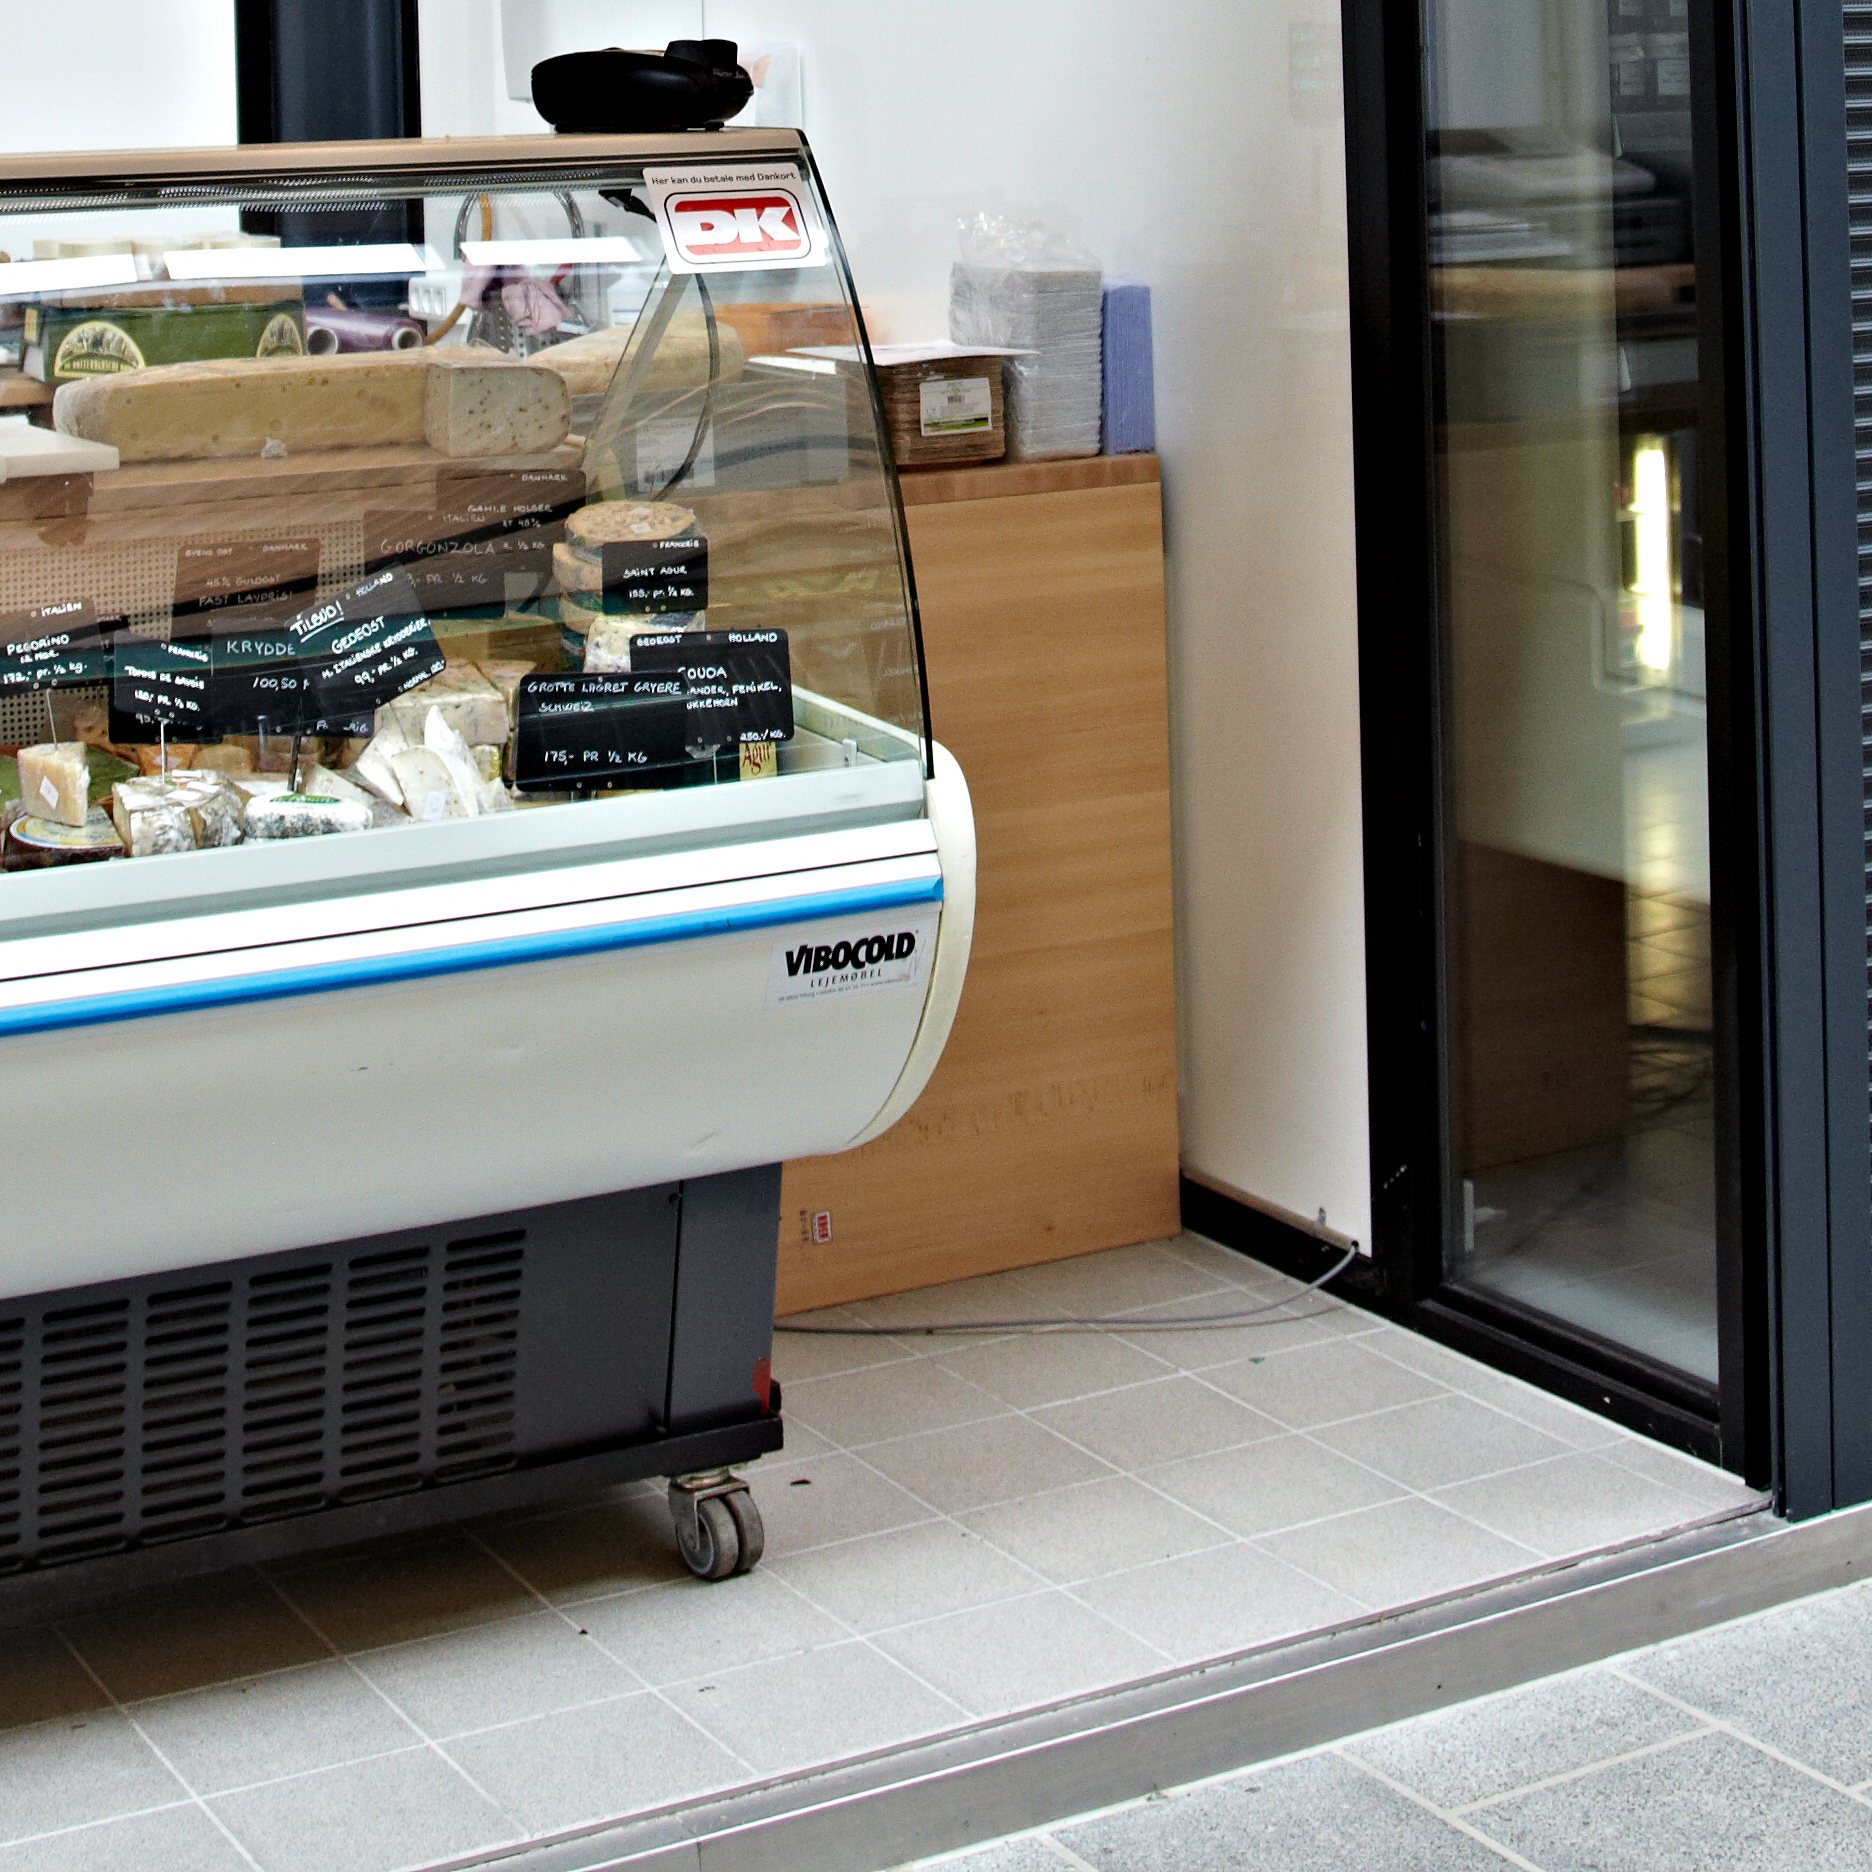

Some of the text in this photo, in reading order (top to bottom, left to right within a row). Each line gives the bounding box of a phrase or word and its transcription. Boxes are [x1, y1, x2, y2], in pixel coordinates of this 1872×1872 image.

[651, 171, 797, 185] Her kan du betale med Dankort
[675, 206, 801, 246] DK
[521, 473, 568, 483] DANMARK
[380, 538, 496, 556] GORGONZOLA
[198, 595, 229, 608] FAST
[331, 615, 386, 655] GEDEOST
[636, 632, 778, 646] GEDEOST HOLLAND
[527, 681, 682, 696] GROTTE LAGRET GRYERE
[583, 751, 599, 763] PR
[627, 750, 648, 764] KG
[784, 930, 917, 978] VIBOCOLD
